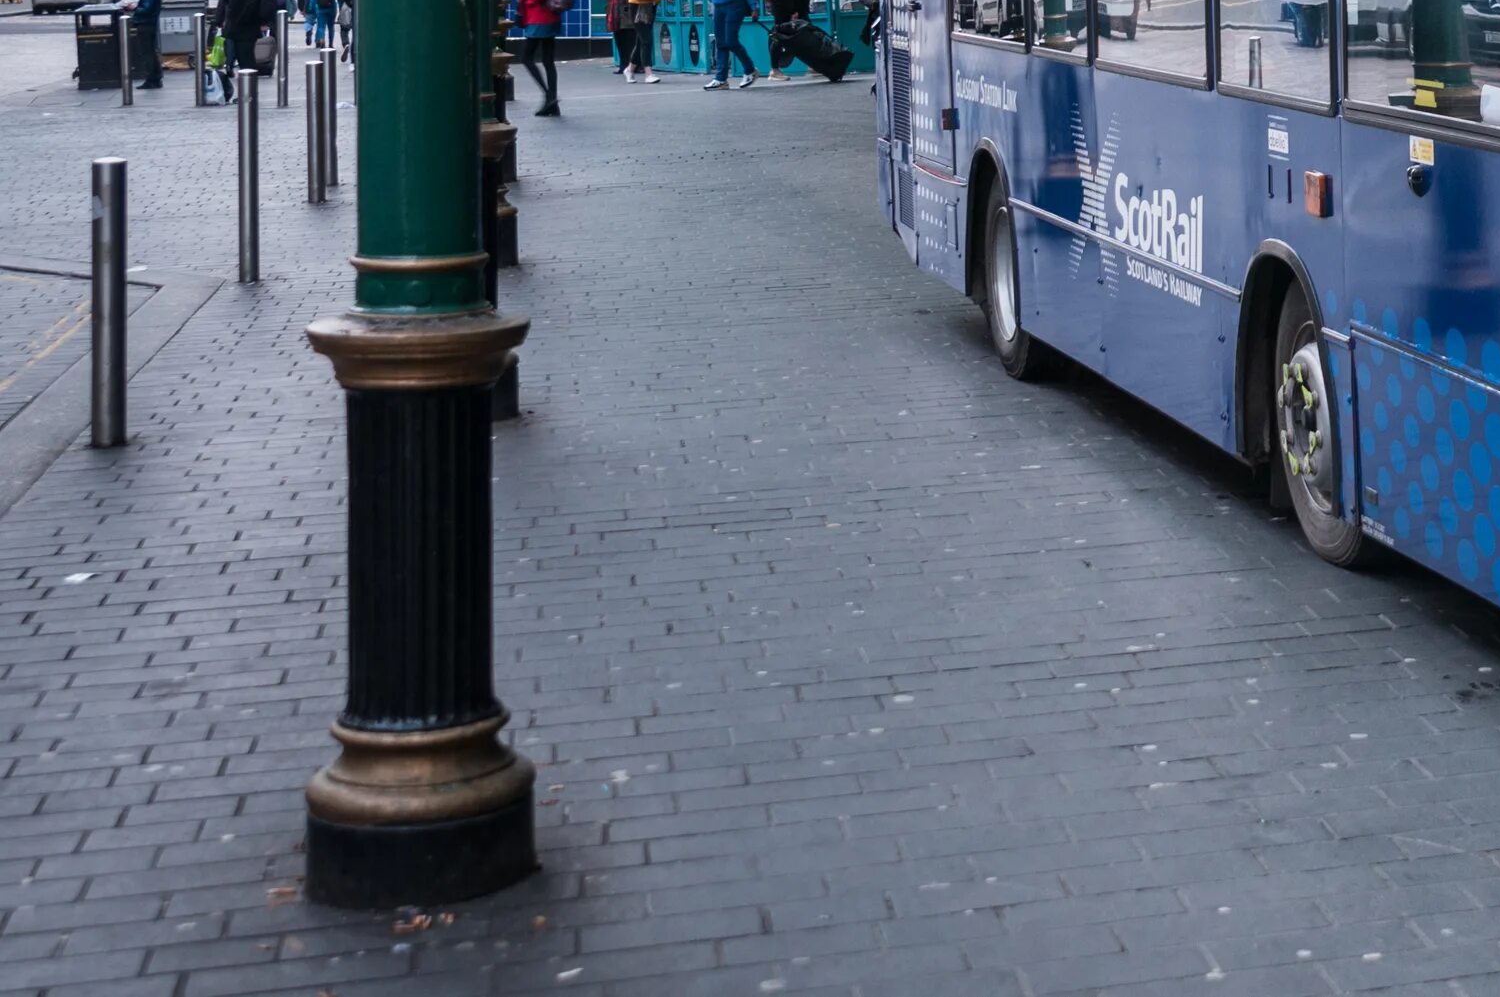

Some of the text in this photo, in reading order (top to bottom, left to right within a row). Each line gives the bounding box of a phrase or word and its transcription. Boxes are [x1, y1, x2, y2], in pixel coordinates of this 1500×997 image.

[956, 69, 1018, 113] GLASGOW STATION LINK
[1115, 172, 1203, 274] ScotRail
[1126, 254, 1202, 307] SCOTLAND'S RAILWAY
